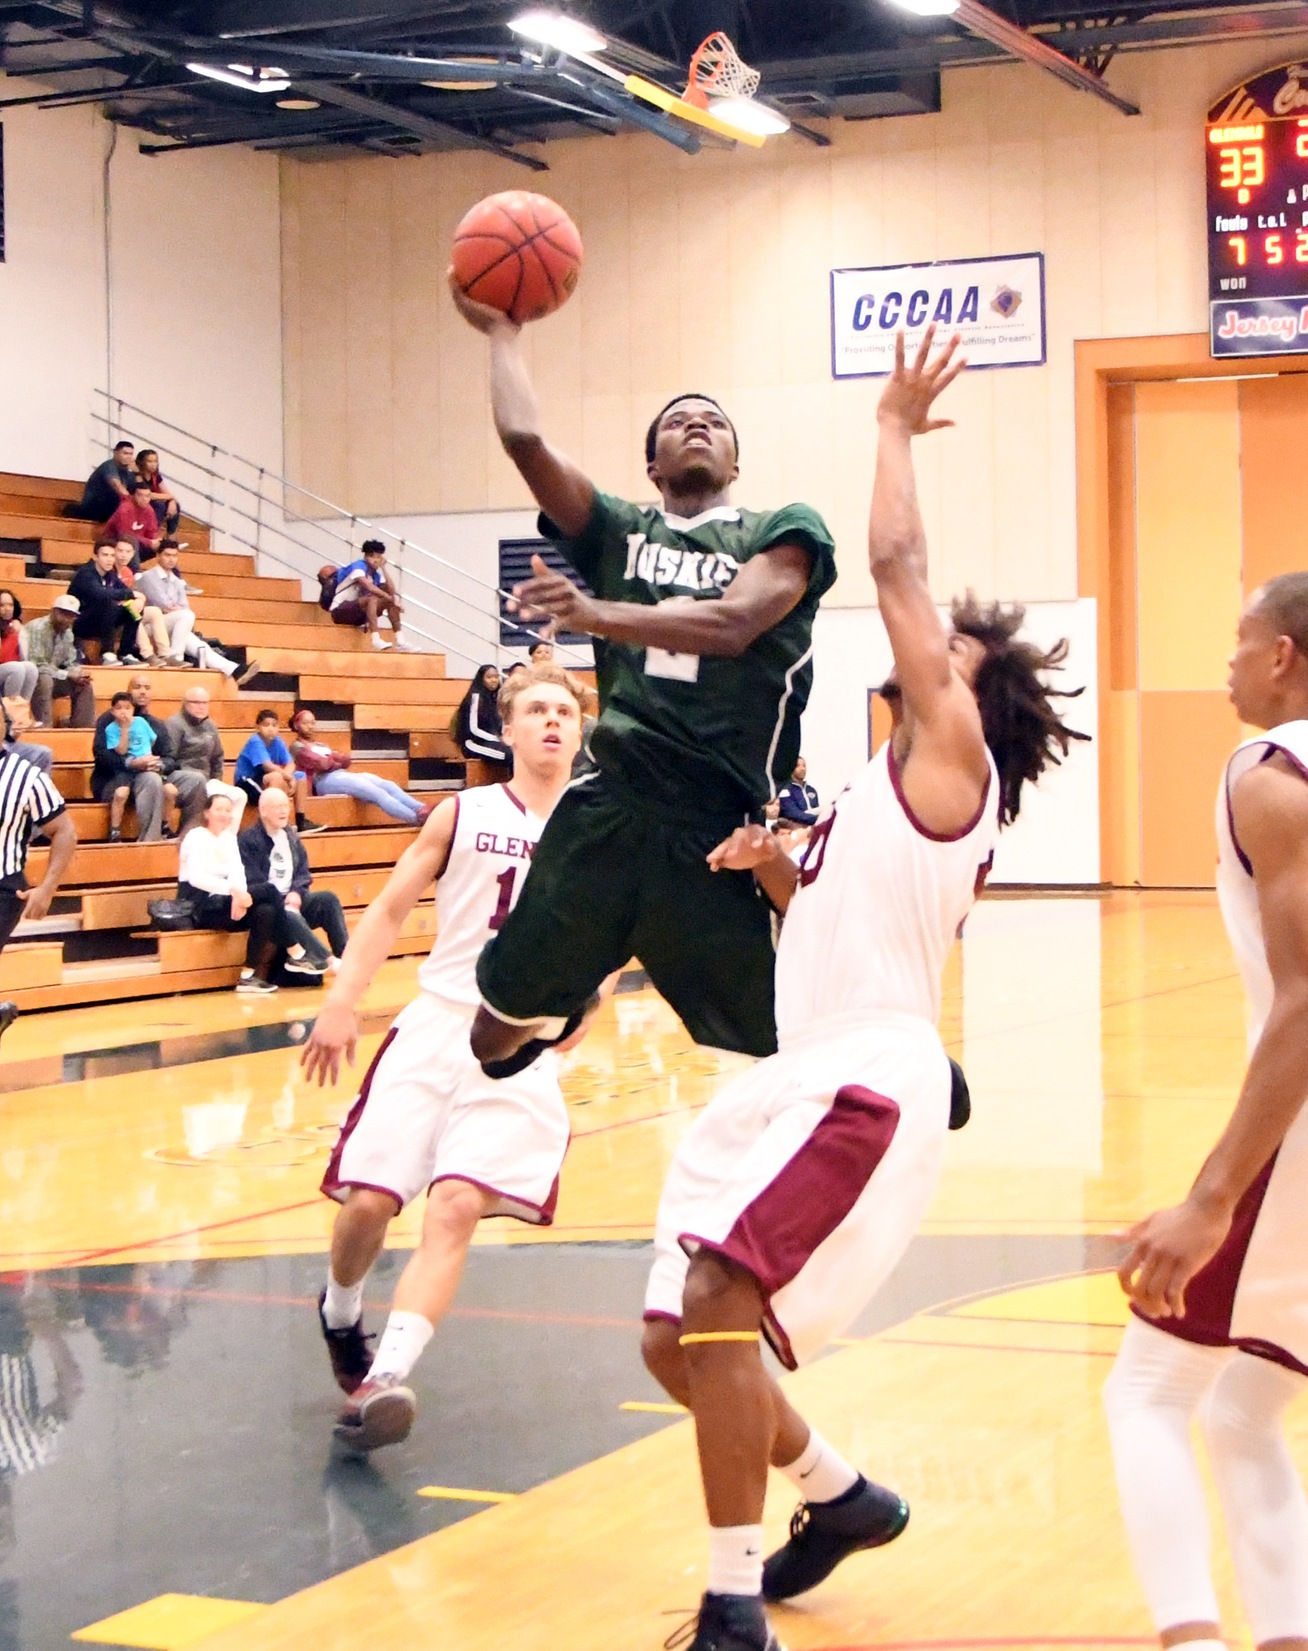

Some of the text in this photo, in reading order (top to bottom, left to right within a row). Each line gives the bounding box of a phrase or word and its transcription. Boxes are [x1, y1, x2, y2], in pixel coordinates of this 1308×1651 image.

[1220, 147, 1264, 187] 33
[1228, 237, 1246, 265] 7
[1265, 235, 1283, 264] 5
[1220, 277, 1247, 290] won
[852, 286, 979, 331] CCCAA
[1218, 311, 1297, 341] Jersey
[475, 832, 540, 860] GLEN
